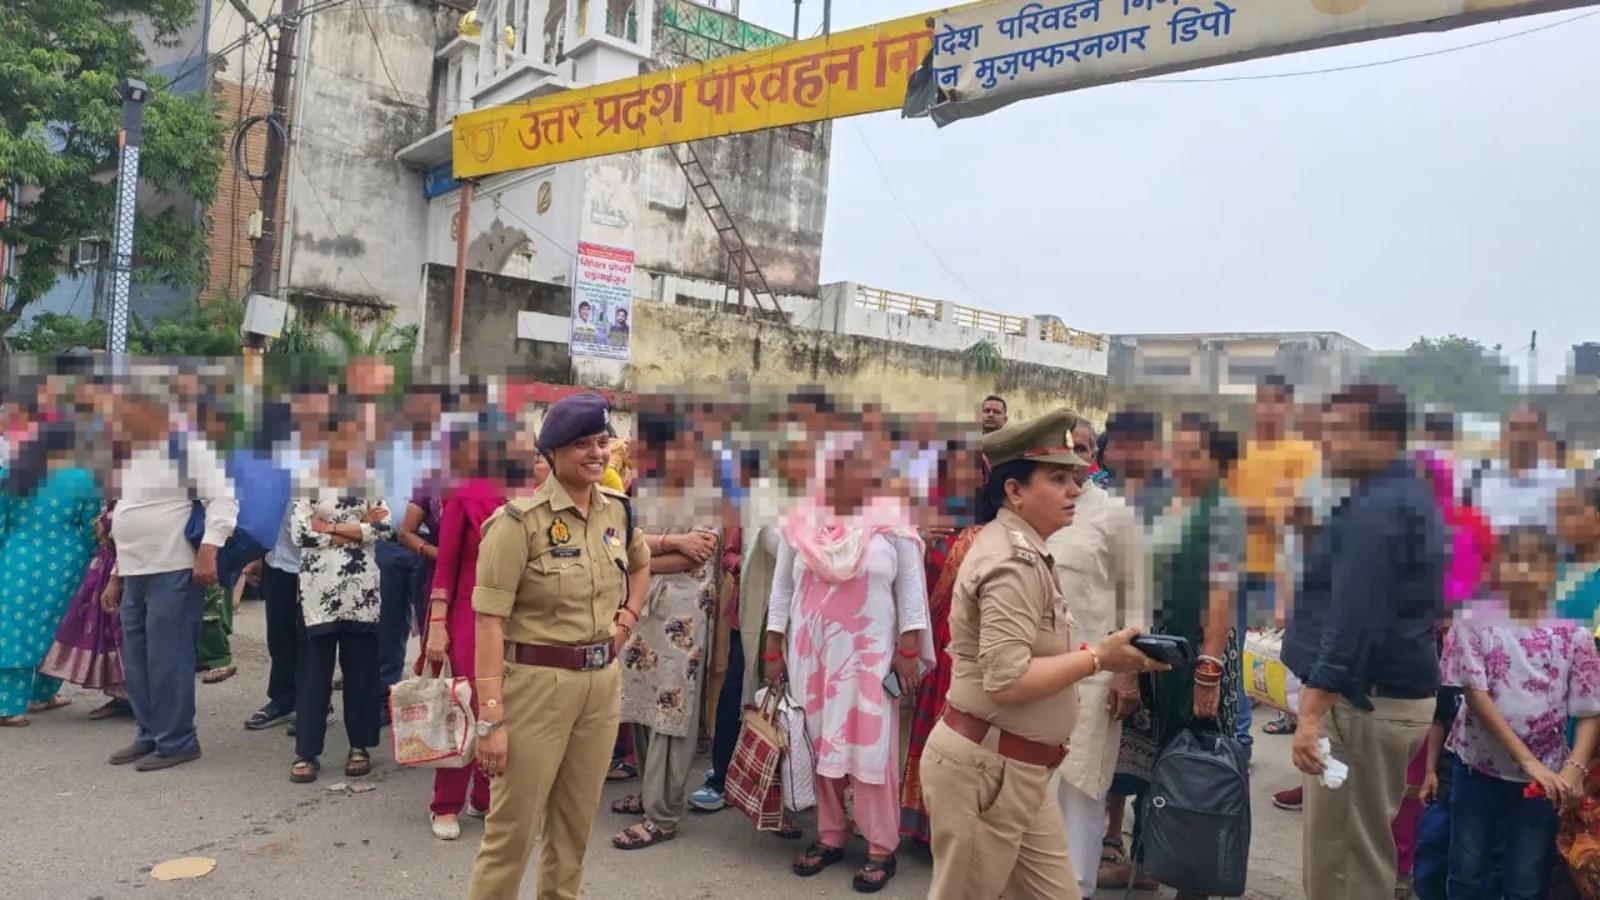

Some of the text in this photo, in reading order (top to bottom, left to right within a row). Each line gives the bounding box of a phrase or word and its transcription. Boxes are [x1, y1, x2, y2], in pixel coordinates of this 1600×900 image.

[934, 23, 984, 55] देश
[996, 0, 1100, 40] परिवहन
[1166, 1, 1237, 45] डिपो
[518, 101, 587, 151] उत्तर
